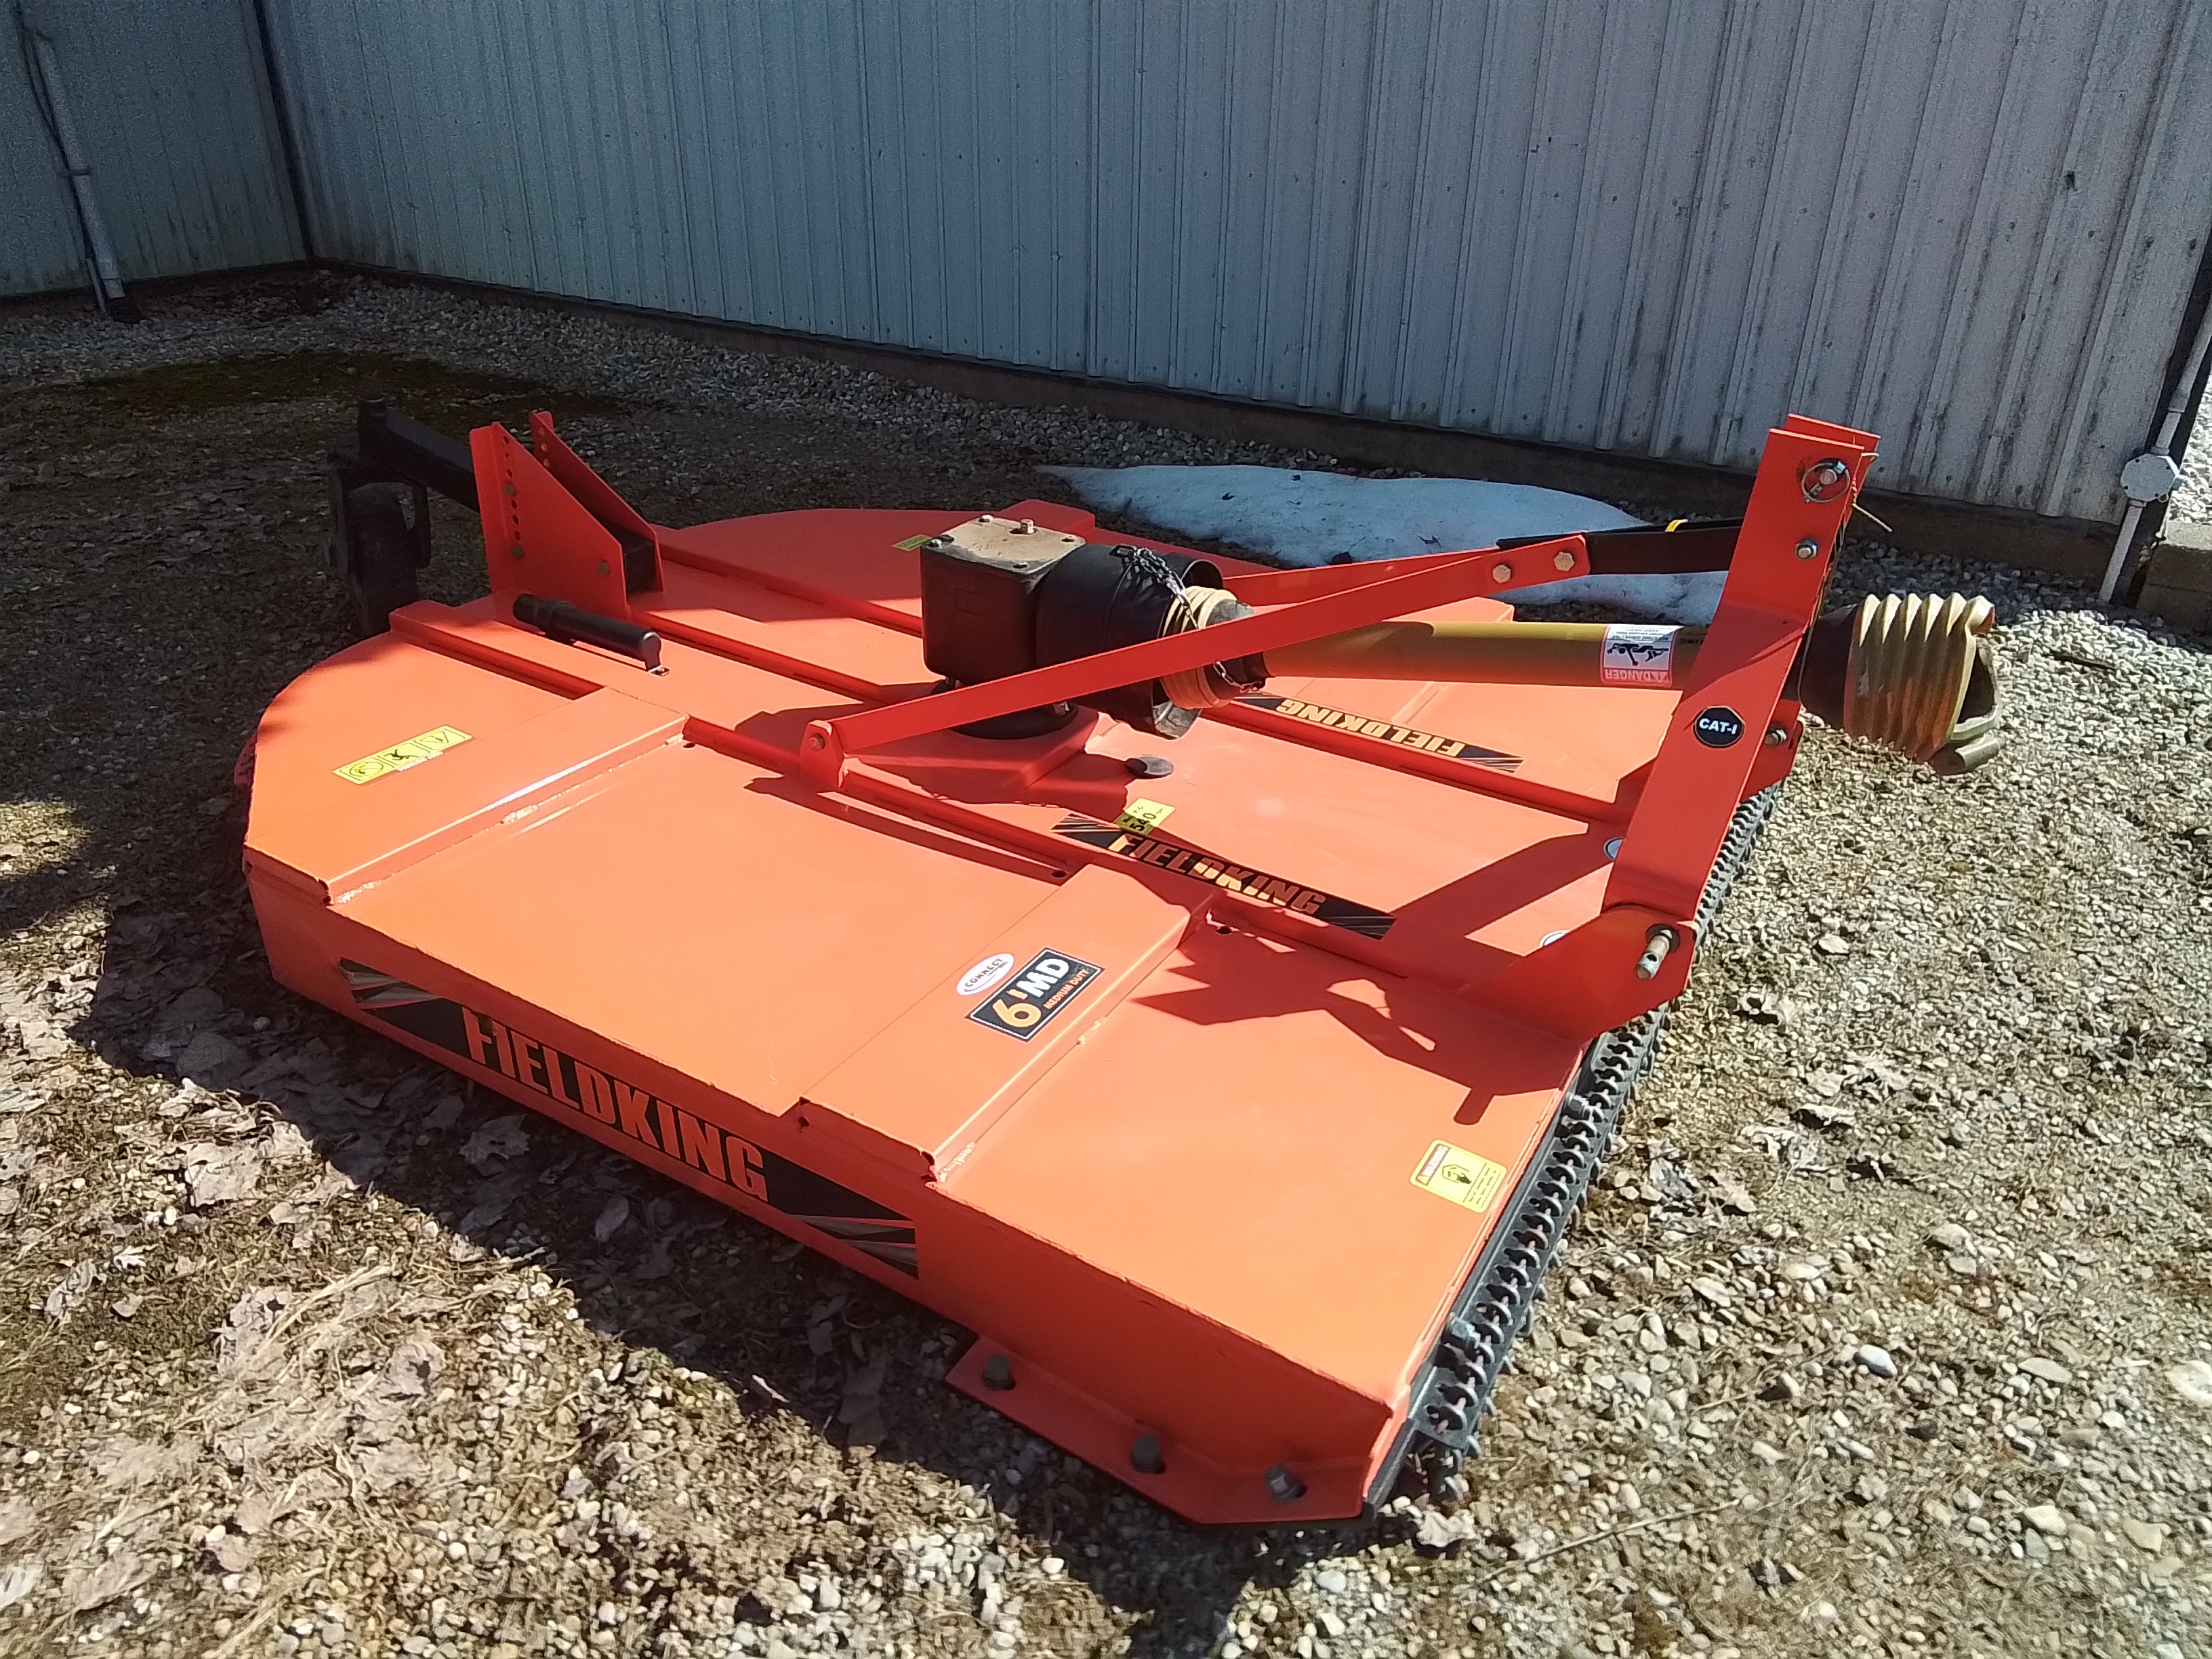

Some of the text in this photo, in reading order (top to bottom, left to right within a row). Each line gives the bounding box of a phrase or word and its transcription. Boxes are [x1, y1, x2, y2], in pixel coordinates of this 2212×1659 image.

[1604, 670, 1652, 681] DANGER
[1276, 698, 1467, 757] FIELDKING
[1129, 813, 1157, 832] 540
[1108, 834, 1328, 915] FIELDKING
[964, 958, 1004, 988] CONNECT
[1043, 968, 1090, 1010] MEDIUM DUTY
[461, 1006, 769, 1204] FIELDKING
